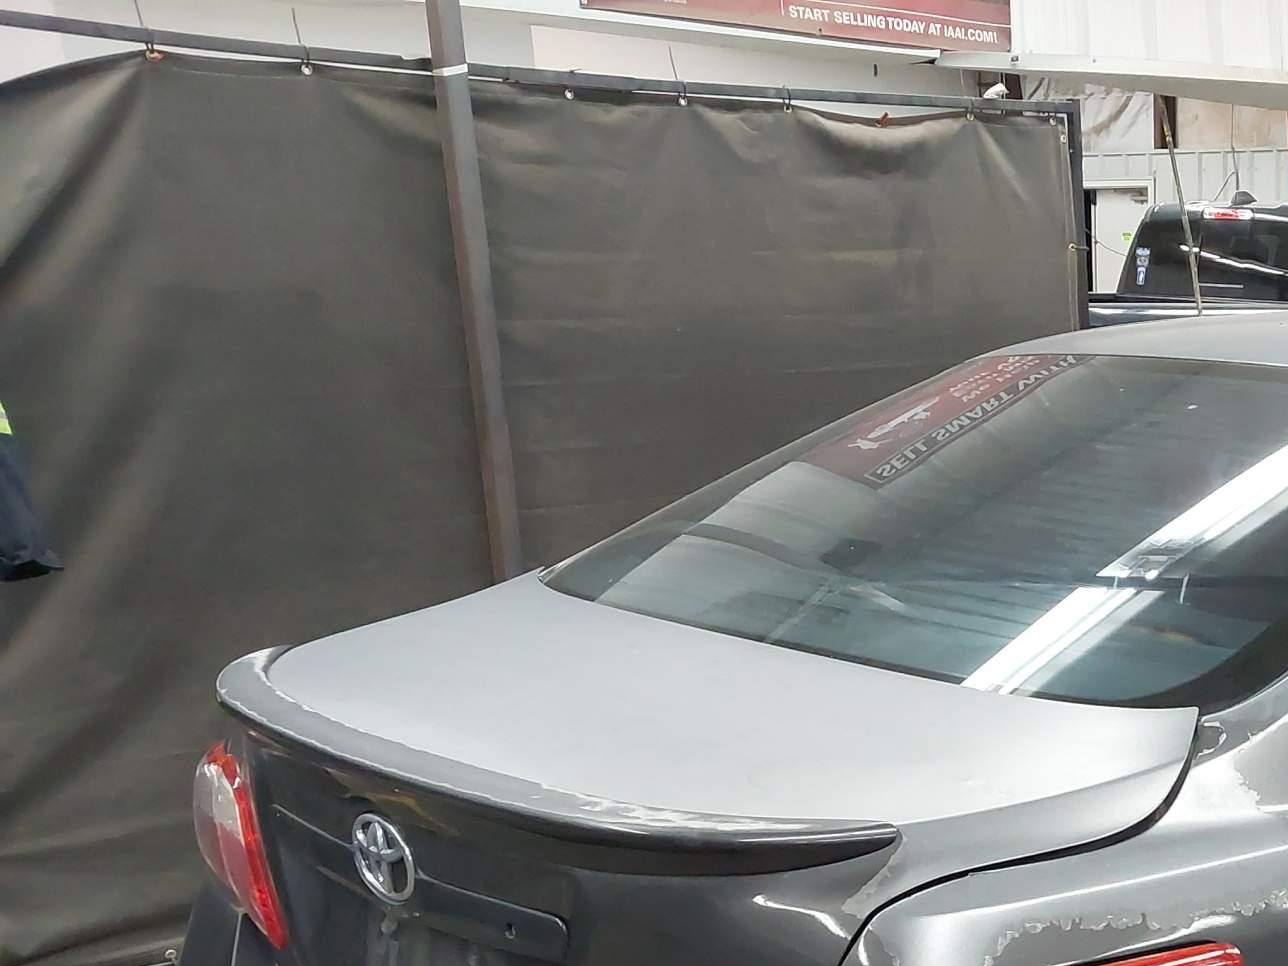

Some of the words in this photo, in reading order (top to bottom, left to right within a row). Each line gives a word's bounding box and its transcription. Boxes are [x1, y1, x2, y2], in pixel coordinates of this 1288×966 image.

[788, 5, 830, 22] START
[834, 11, 885, 29] SELLING
[886, 16, 926, 34] TODAY
[927, 23, 942, 36] AT
[943, 25, 998, 44] IAAI.COM!
